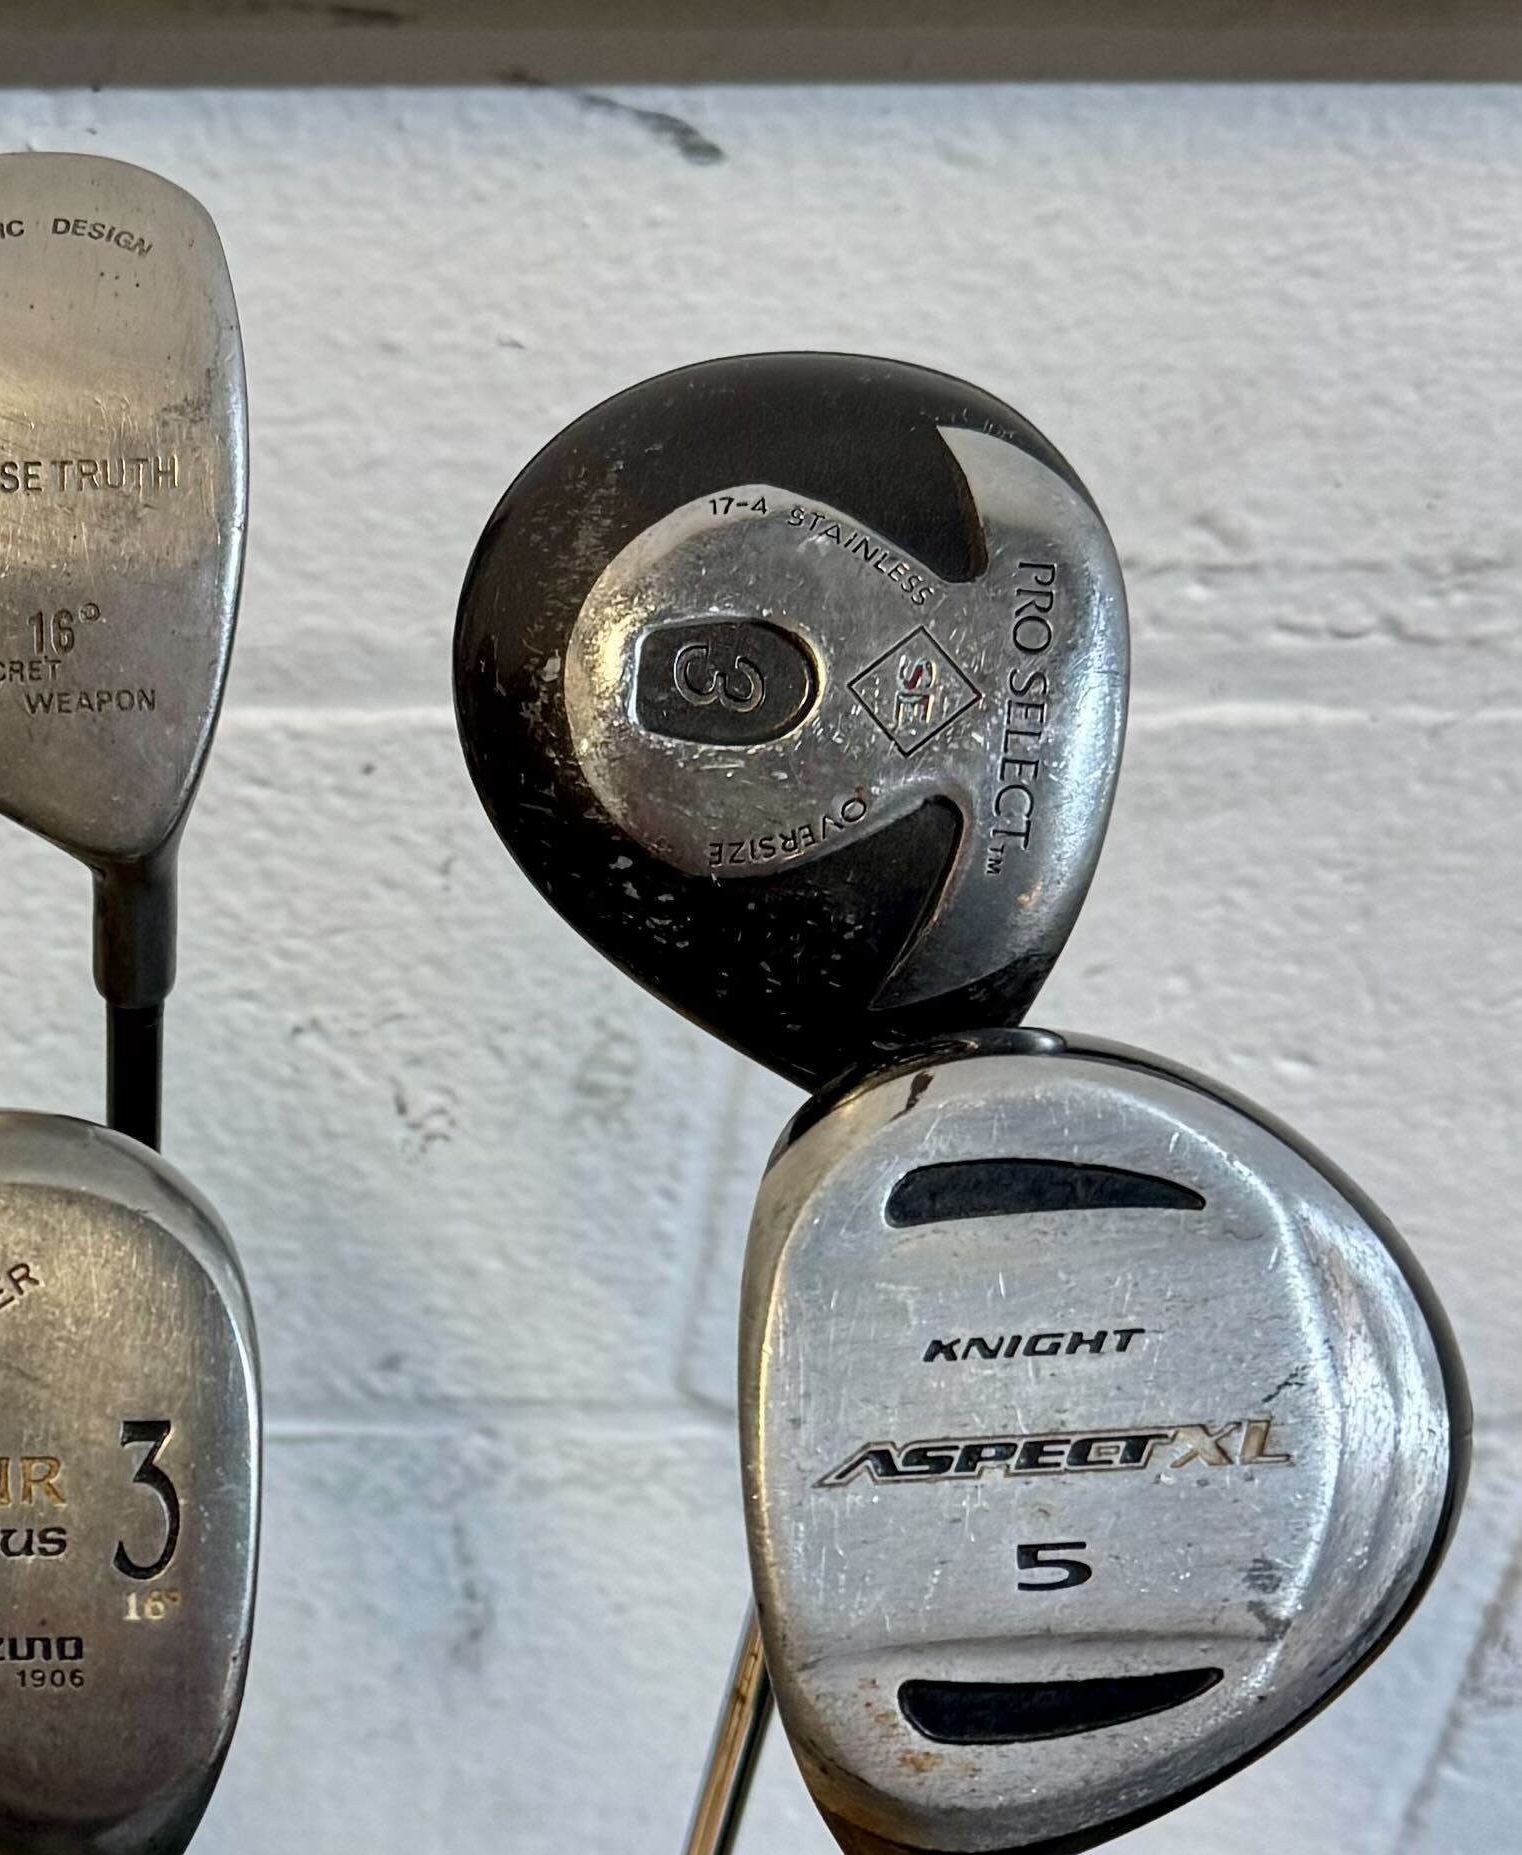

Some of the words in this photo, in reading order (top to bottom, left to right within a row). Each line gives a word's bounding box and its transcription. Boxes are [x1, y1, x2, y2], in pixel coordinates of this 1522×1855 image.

[51, 216, 155, 258] DESIGN
[51, 455, 180, 493] TRUTH
[707, 495, 769, 517] 17-4
[786, 505, 938, 607] STAINLESS
[1011, 560, 1058, 657] PRO
[23, 688, 157, 715] WEAPON
[673, 642, 767, 714] 3
[707, 795, 868, 868] OVERSIZE
[922, 1327, 1146, 1363] KNIGHT
[112, 1419, 182, 1581] 3
[1015, 1540, 1094, 1592] 5
[16, 1668, 85, 1690] 1906
